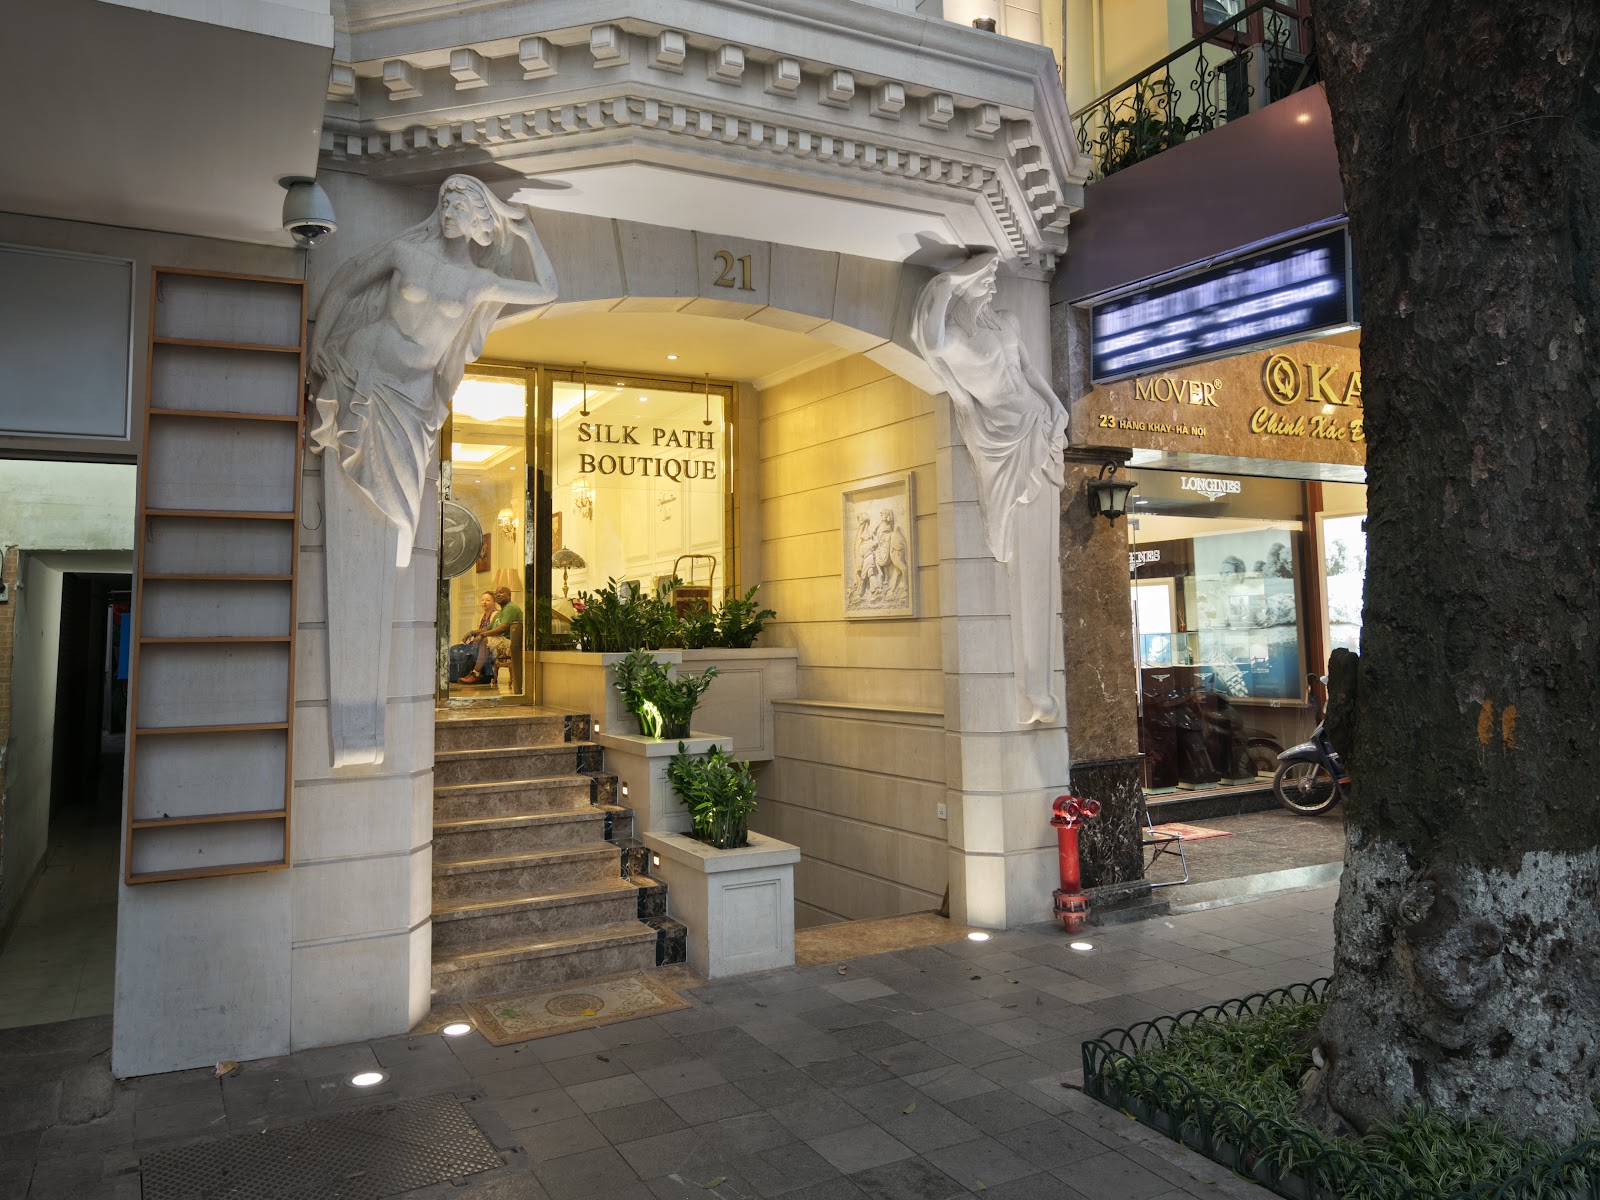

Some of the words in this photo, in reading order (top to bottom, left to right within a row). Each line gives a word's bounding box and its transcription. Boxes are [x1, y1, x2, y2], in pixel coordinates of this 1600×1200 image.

[713, 249, 756, 291] 21
[577, 422, 641, 446] SILK
[651, 427, 715, 450] PATH
[1098, 414, 1117, 429] 23
[1119, 417, 1146, 432] HÀNG
[578, 453, 717, 483] BOUTIQUE
[1180, 476, 1241, 494] LONGINES
